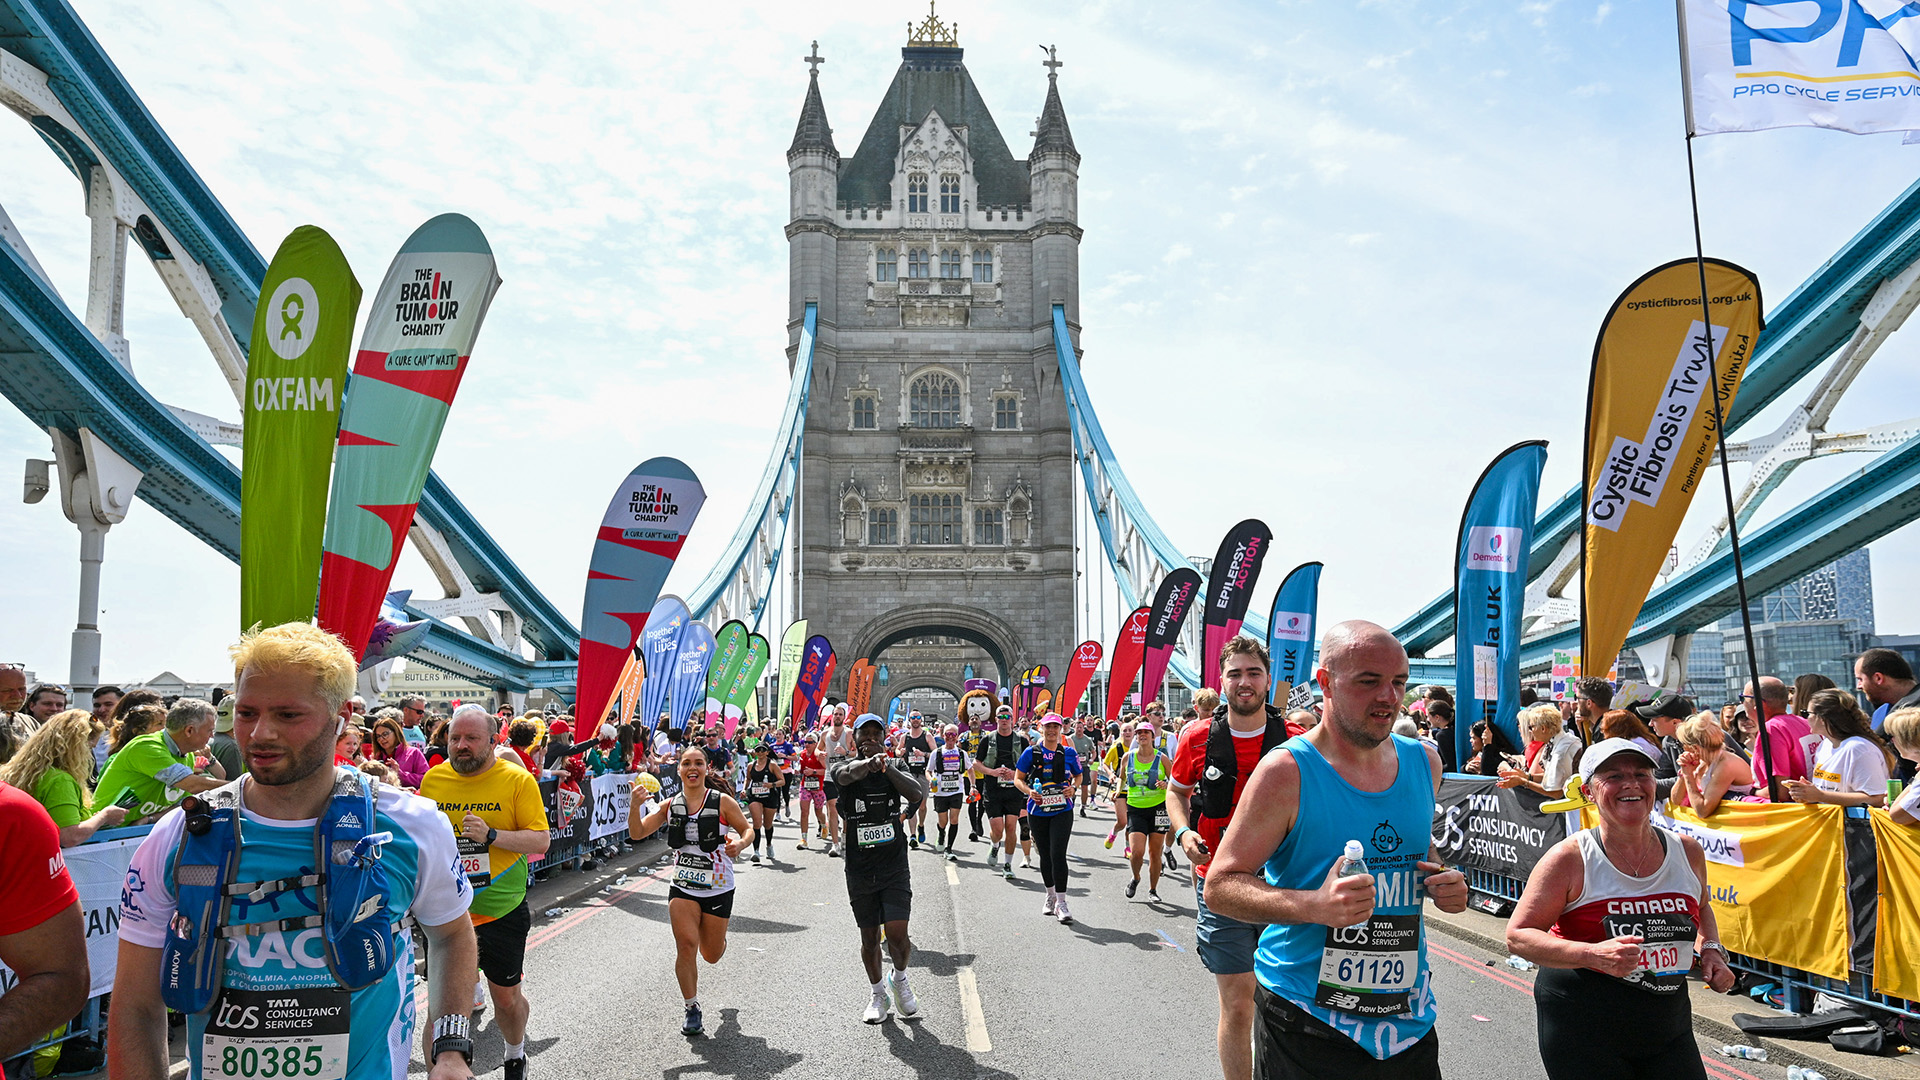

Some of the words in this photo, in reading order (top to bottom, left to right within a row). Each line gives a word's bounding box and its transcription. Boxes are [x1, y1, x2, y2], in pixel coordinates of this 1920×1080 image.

[1733, 83, 1780, 99] PRO
[1784, 84, 1840, 102] CYCLE
[415, 268, 433, 281] THE
[400, 271, 453, 302] BRAIN
[1627, 291, 1752, 311] cysticfibrosi.org.uk
[395, 300, 459, 322] TUMOUR
[401, 323, 446, 337] CHARITY
[387, 354, 394, 366] A
[395, 354, 412, 367] CURE
[413, 353, 434, 366] CAN'T
[435, 353, 456, 366] WAIT
[253, 377, 334, 412] OXFAM
[1681, 456, 1703, 494] Fighting
[1699, 441, 1708, 458] for
[1717, 335, 1749, 401] Unlimited
[1629, 404, 1688, 497] Fibrosis
[642, 484, 656, 492] THE
[1592, 444, 1639, 521] Cystic
[631, 487, 672, 504] BRAIN
[628, 502, 679, 515] TUMOUR
[634, 514, 669, 523] CHARITY
[630, 530, 644, 538] CURE
[1234, 536, 1261, 590] ACTION
[1216, 541, 1247, 610] EPILEPSY
[1170, 581, 1192, 623] ACTION
[1487, 585, 1502, 620] UK
[1155, 584, 1181, 636] EPILEPSY
[646, 626, 674, 641] together
[654, 640, 678, 654] lives
[1283, 648, 1297, 671] UK
[635, 661, 643, 676] UK
[682, 662, 703, 674] lives
[404, 673, 440, 681] BUTLERS
[461, 802, 502, 812] AFRICA
[1465, 793, 1501, 813] TATA
[863, 827, 892, 841] 60815
[1468, 815, 1546, 848] CONSULTANCY
[1468, 837, 1518, 864] SERVICES
[461, 859, 480, 873] 26
[679, 855, 692, 866] tcs
[1369, 855, 1403, 864] ORMOND
[1404, 853, 1425, 862] STREET
[1388, 862, 1410, 870] CHARITY
[678, 869, 706, 883] 64346
[1377, 870, 1425, 908] MIE
[1607, 898, 1689, 915] CANADA
[1372, 929, 1415, 938] CONSULTANCY
[1609, 919, 1645, 939] tcs
[1646, 925, 1692, 933] CONSULTANCY
[1371, 938, 1400, 946] SERVICES
[362, 938, 377, 972] AONIJIE
[1638, 947, 1678, 970] 4160
[169, 949, 181, 990] AONIJIE
[289, 973, 333, 981] ANOPHT
[1337, 957, 1405, 985] 61129
[229, 979, 236, 987] &
[1641, 980, 1658, 991] new
[1657, 983, 1681, 992] balanc
[266, 998, 300, 1008] TATA
[1358, 1005, 1377, 1014] new
[215, 996, 260, 1030] tcs
[265, 1006, 342, 1019] CONSULTANCY
[265, 1019, 313, 1029] SERVICES
[221, 1045, 323, 1078] 80385
